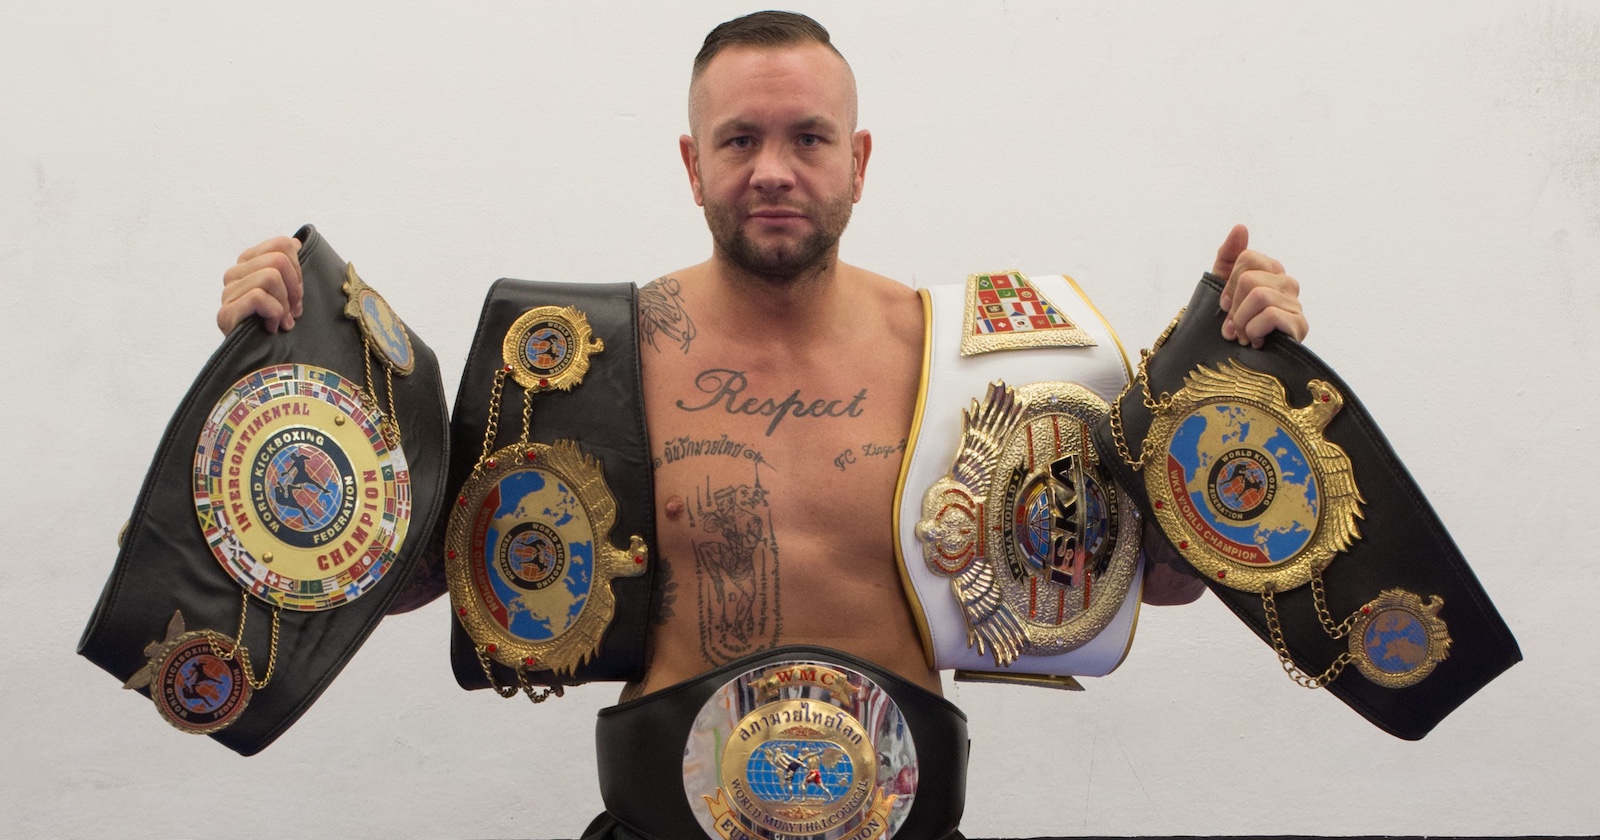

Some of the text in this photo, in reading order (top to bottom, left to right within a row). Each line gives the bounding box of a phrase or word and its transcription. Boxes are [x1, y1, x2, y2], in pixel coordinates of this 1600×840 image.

[519, 332, 531, 369] FEDERATION
[547, 322, 573, 374] WORLD KICKBOXING
[676, 368, 868, 437] Respect
[228, 402, 310, 533] INTERCONTINENTAL
[254, 431, 325, 533] WORLD KICKBOXING
[1221, 450, 1275, 506] WORLD KICKBOXING
[313, 475, 354, 544] FEDERATION
[316, 469, 379, 572] CHAMPION
[1004, 484, 1018, 566] MMA WORLD
[1050, 455, 1083, 587] ISKA
[1170, 469, 1258, 561] WKF WORLD CHAMPION
[1209, 484, 1243, 519] FEDERATION
[474, 506, 499, 612] WORLD CHAMPION
[501, 534, 515, 581] FEDERATION
[532, 523, 564, 589] WORLD KICKBOXING
[166, 645, 213, 718] WORLD KICKBOXIN
[214, 668, 242, 719] FEDERATION
[774, 669, 835, 686] WMC
[739, 702, 863, 745] สภามวยไทยโลก
[731, 778, 761, 818] WORLD
[829, 778, 869, 824] COUNCIL
